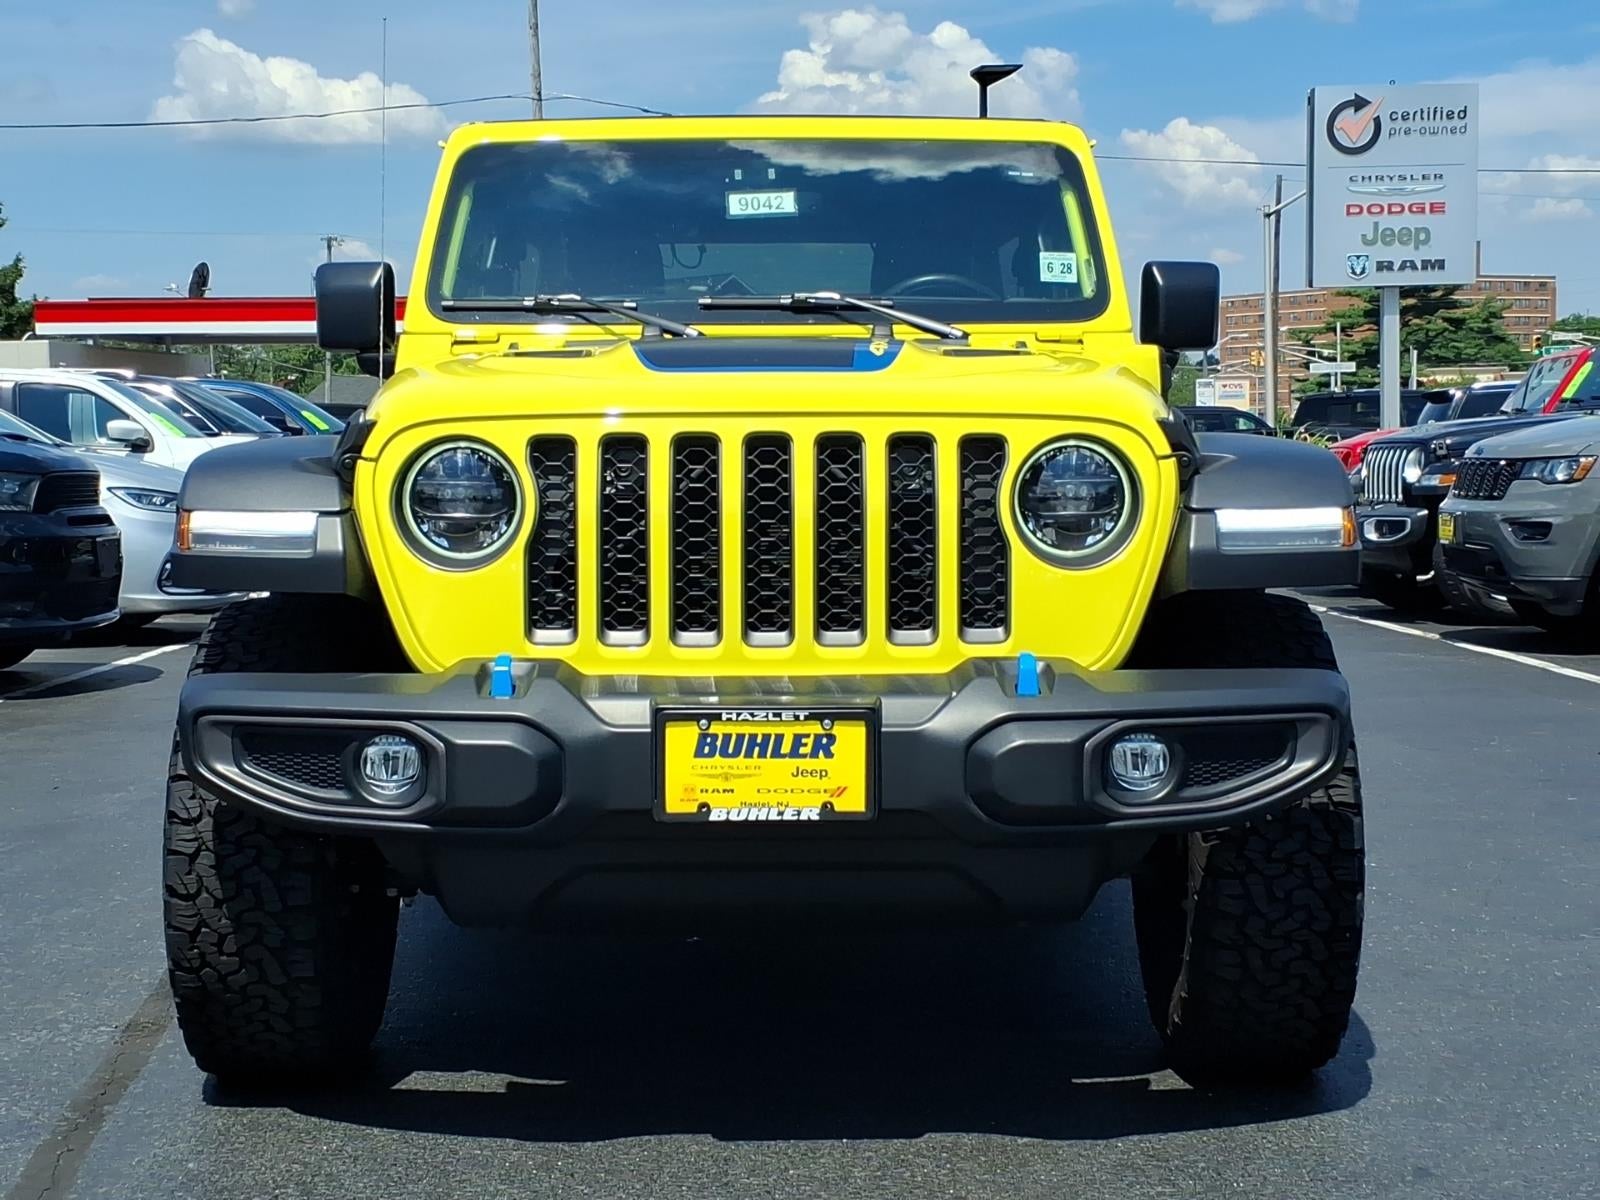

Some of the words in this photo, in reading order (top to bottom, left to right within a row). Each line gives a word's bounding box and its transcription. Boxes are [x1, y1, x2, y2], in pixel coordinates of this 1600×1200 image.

[1388, 105, 1468, 123] certified
[1388, 122, 1468, 139] pre-owned
[1349, 173, 1444, 183] CHRYSLER
[738, 195, 785, 211] 9042
[1346, 202, 1446, 216] DODGE
[1361, 221, 1431, 250] Jeep
[1047, 262, 1054, 273] 6
[1060, 262, 1073, 274] 28
[1375, 258, 1446, 272] RAM
[721, 711, 810, 721] HAZLET
[693, 732, 837, 759] BUHLER
[791, 766, 829, 780] Jeep
[708, 807, 821, 821] BUHLER
